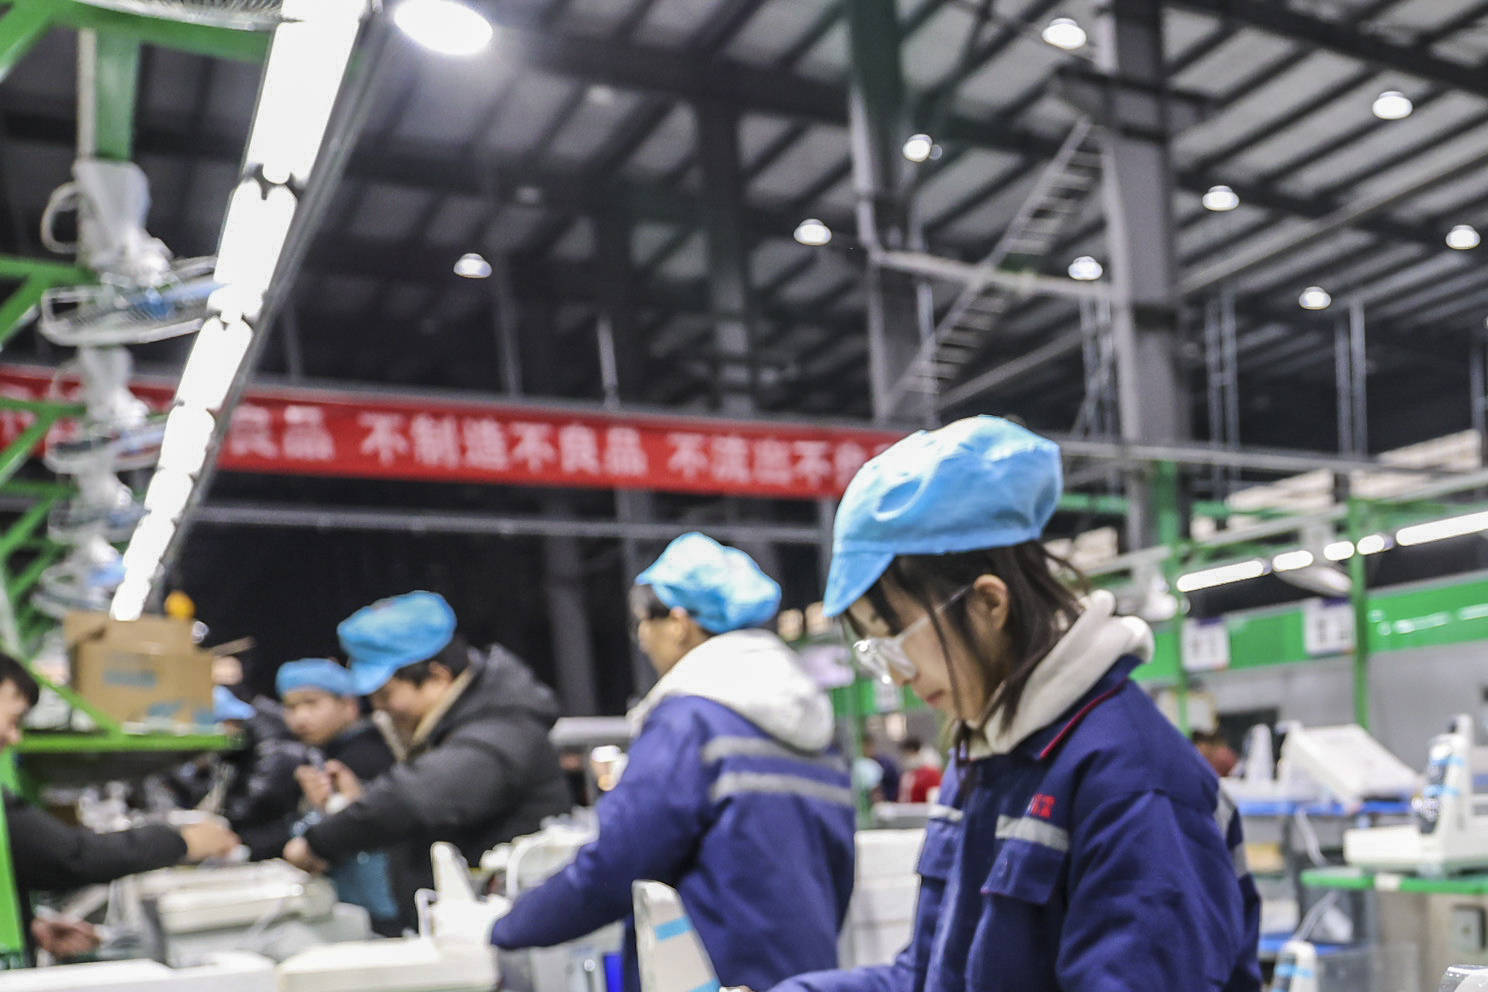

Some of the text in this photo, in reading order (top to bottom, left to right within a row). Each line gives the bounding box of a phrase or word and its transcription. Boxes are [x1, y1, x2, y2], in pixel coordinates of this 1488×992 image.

[357, 411, 648, 477] 不制造不良品
